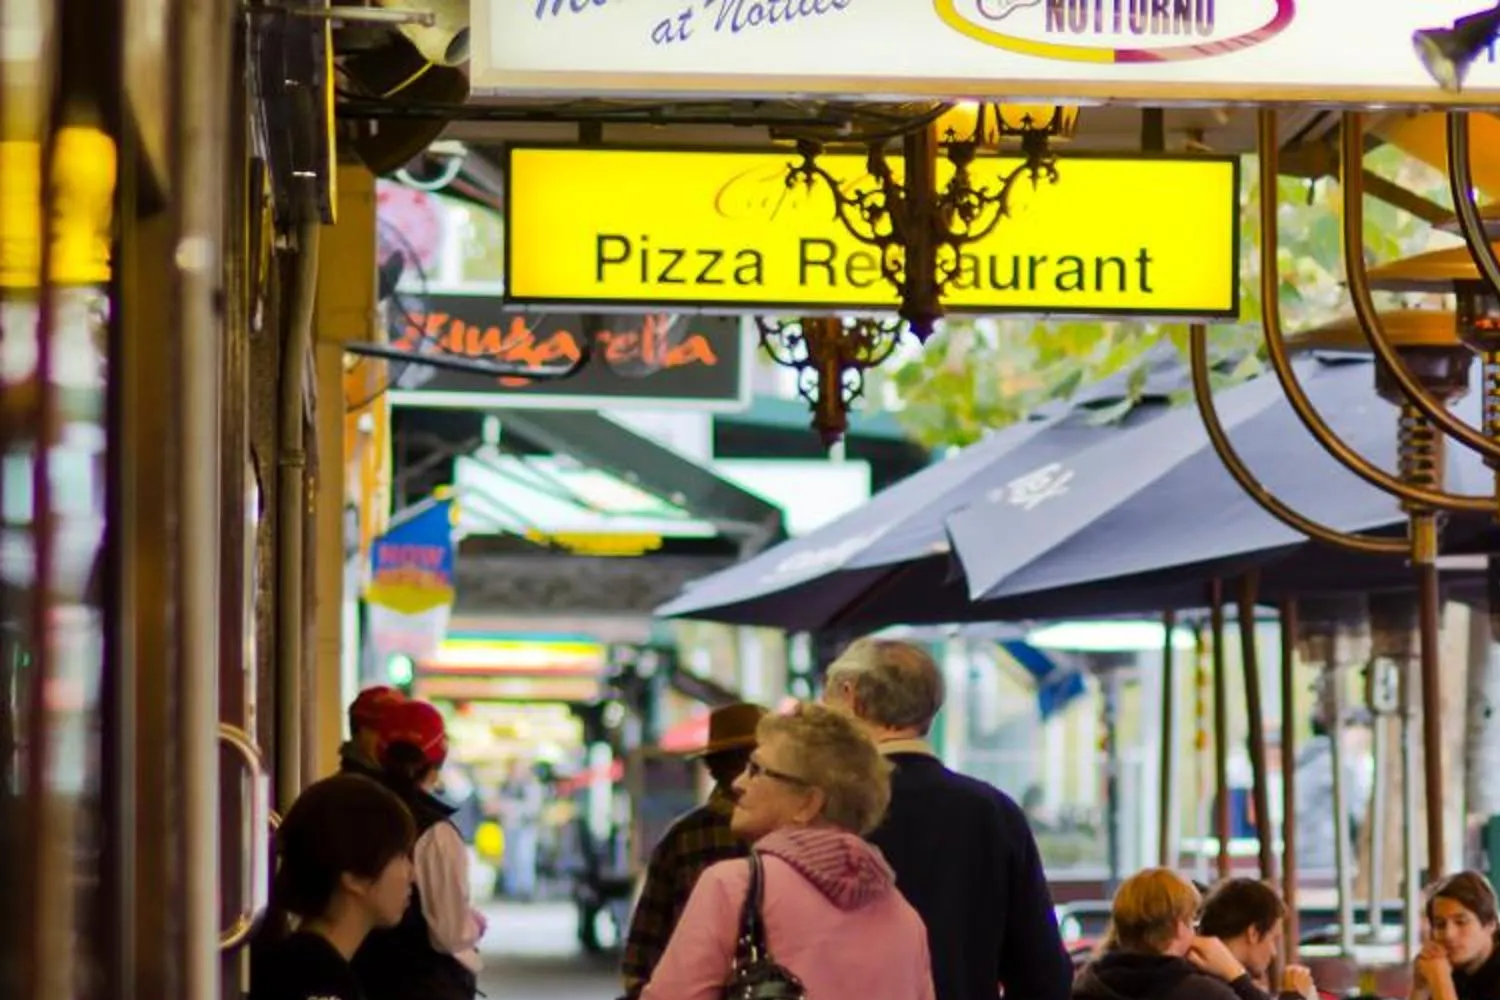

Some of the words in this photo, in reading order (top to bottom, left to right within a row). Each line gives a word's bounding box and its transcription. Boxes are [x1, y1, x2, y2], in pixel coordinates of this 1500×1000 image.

[651, 7, 694, 45] at
[595, 234, 764, 286] Pizza
[800, 237, 1154, 294] Reaurant
